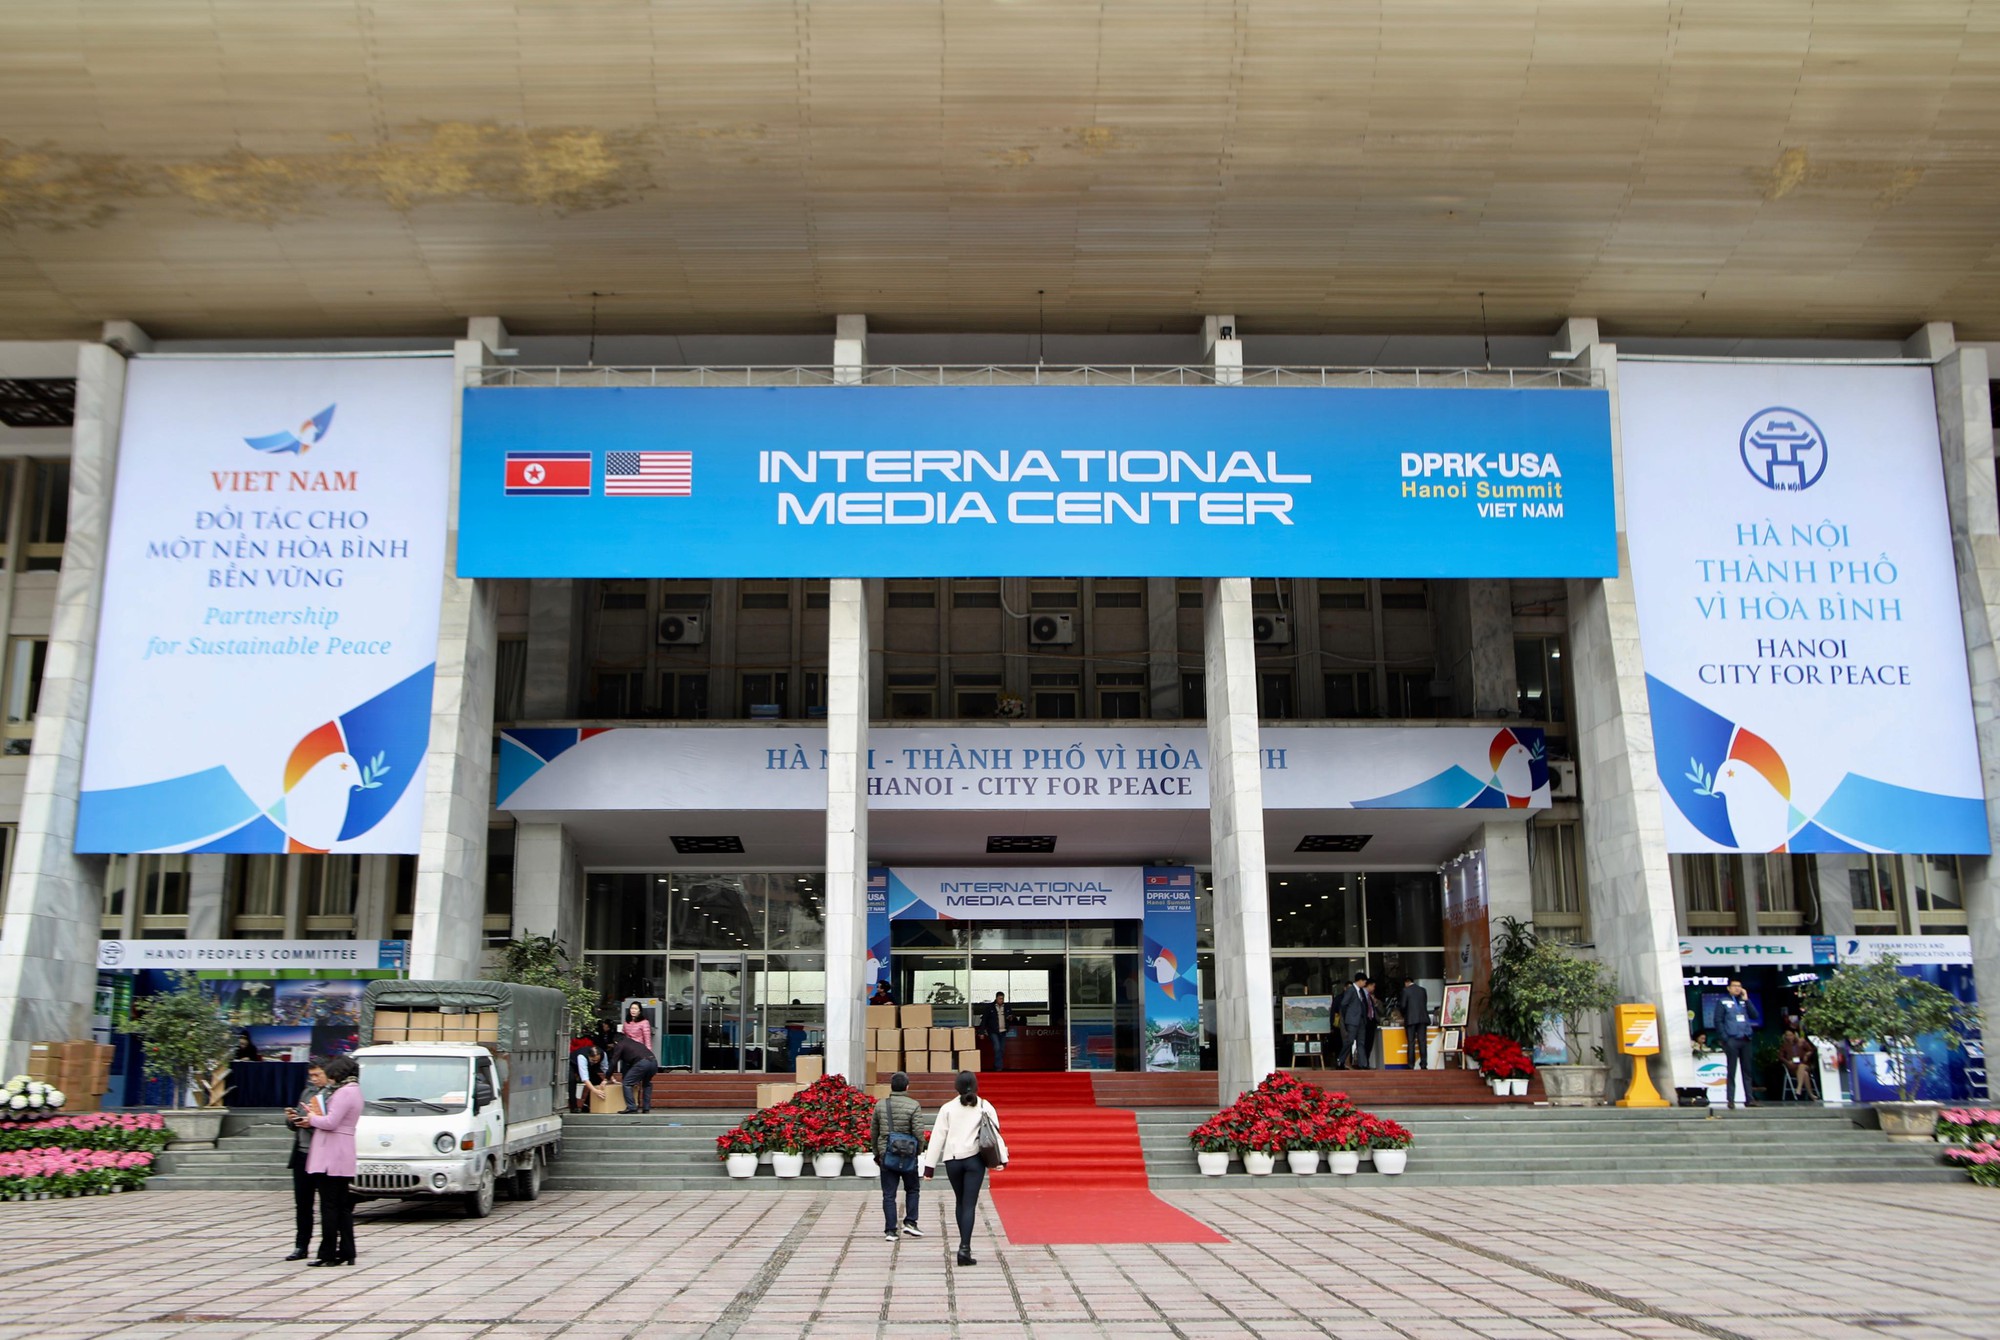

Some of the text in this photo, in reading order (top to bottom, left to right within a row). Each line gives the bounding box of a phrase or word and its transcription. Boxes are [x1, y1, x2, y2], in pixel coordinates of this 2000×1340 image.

[759, 449, 1312, 483] INTERNATIONAL
[1401, 452, 1562, 478] DPRK-USA
[210, 470, 358, 492] VIET NAM
[1402, 481, 1563, 498] Hanoi Summit
[252, 507, 300, 529] TÁC
[308, 510, 368, 529] CHO
[777, 491, 1294, 525] MEDIA CENTER
[1477, 503, 1564, 518] VIET NAM
[1736, 517, 1851, 552] HÀ NỘI
[278, 535, 332, 558] HÒA
[341, 535, 409, 558] BÌNH
[208, 562, 344, 588] BỀN VỮNG
[1695, 552, 1898, 585] THÀNH PHỐ
[1695, 590, 1903, 622] VÌ HÒA BÌNH
[204, 606, 339, 630] Partnership
[143, 635, 392, 660] for Sustainable Peace
[1757, 638, 1848, 659] HANOI
[1698, 664, 1911, 686] CITY FOR PEACE
[765, 744, 810, 769] HÀ
[902, 744, 1012, 769] THÀNH
[1022, 742, 1085, 769] PHỐ
[1095, 744, 1127, 769] VÌ
[1136, 743, 1203, 769] HÒA
[867, 777, 953, 796] HANOI
[978, 777, 1038, 796] CITY
[1046, 777, 1100, 796] FOR
[1108, 777, 1192, 796] PEACE
[940, 882, 1112, 893] INTERNATIONAL
[1146, 892, 1190, 900] DPRK-USA
[947, 895, 1106, 906] MEDIA CENTER
[143, 949, 358, 960] HANOI PEOPLE'S COMMITTEE
[1704, 944, 1793, 954] VIETTEL
